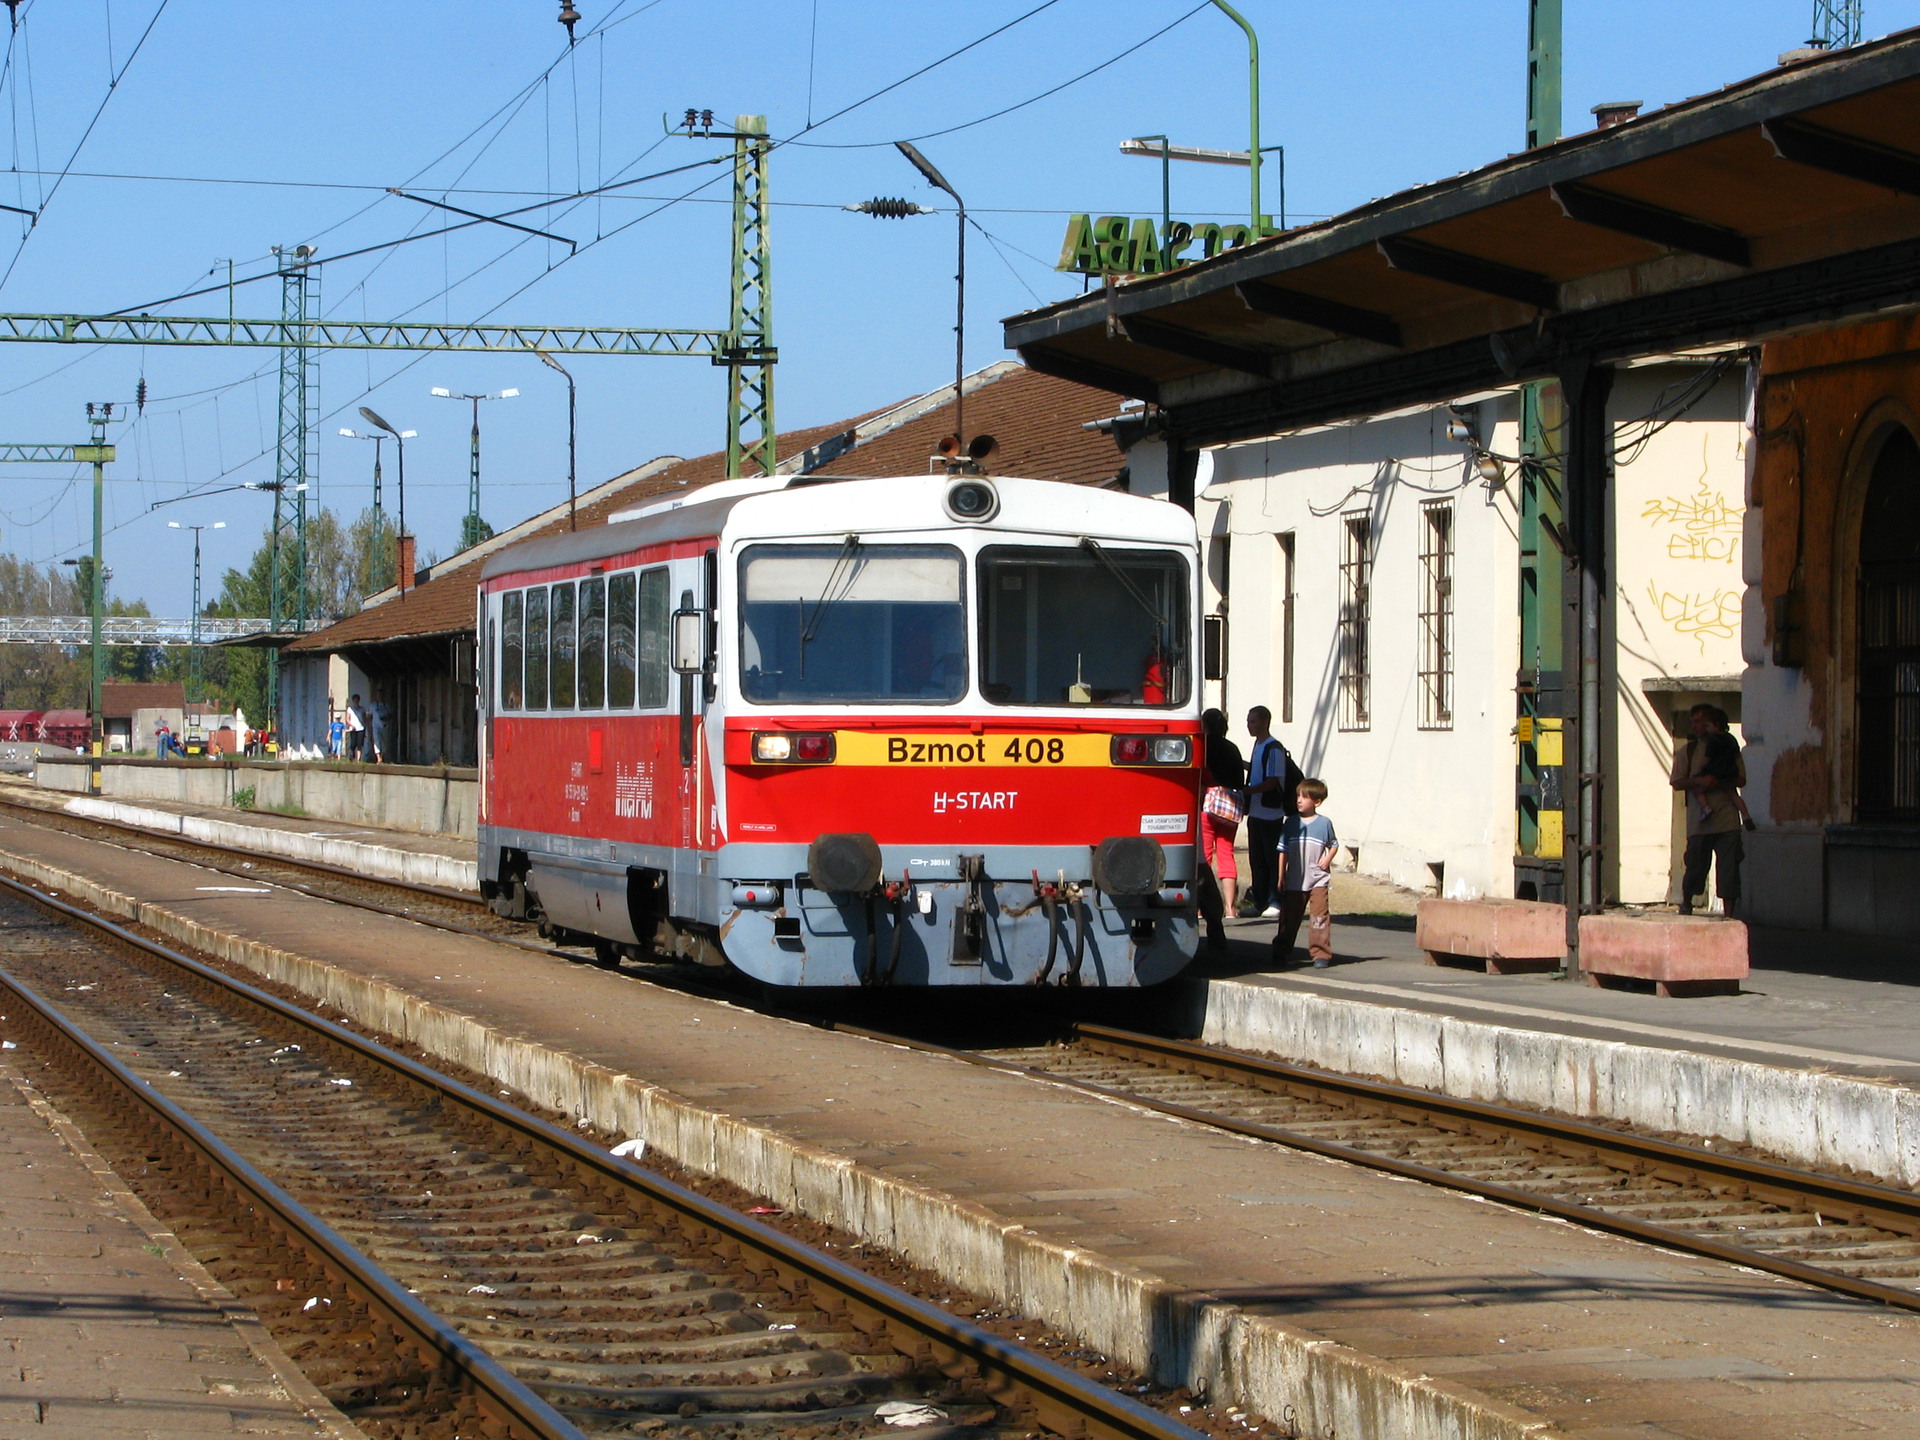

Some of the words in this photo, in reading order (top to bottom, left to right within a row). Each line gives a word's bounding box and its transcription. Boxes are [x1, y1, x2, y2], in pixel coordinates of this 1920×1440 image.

[888, 737, 984, 763] Bzmot
[1004, 738, 1064, 763] 408
[933, 791, 1018, 813] H-START
